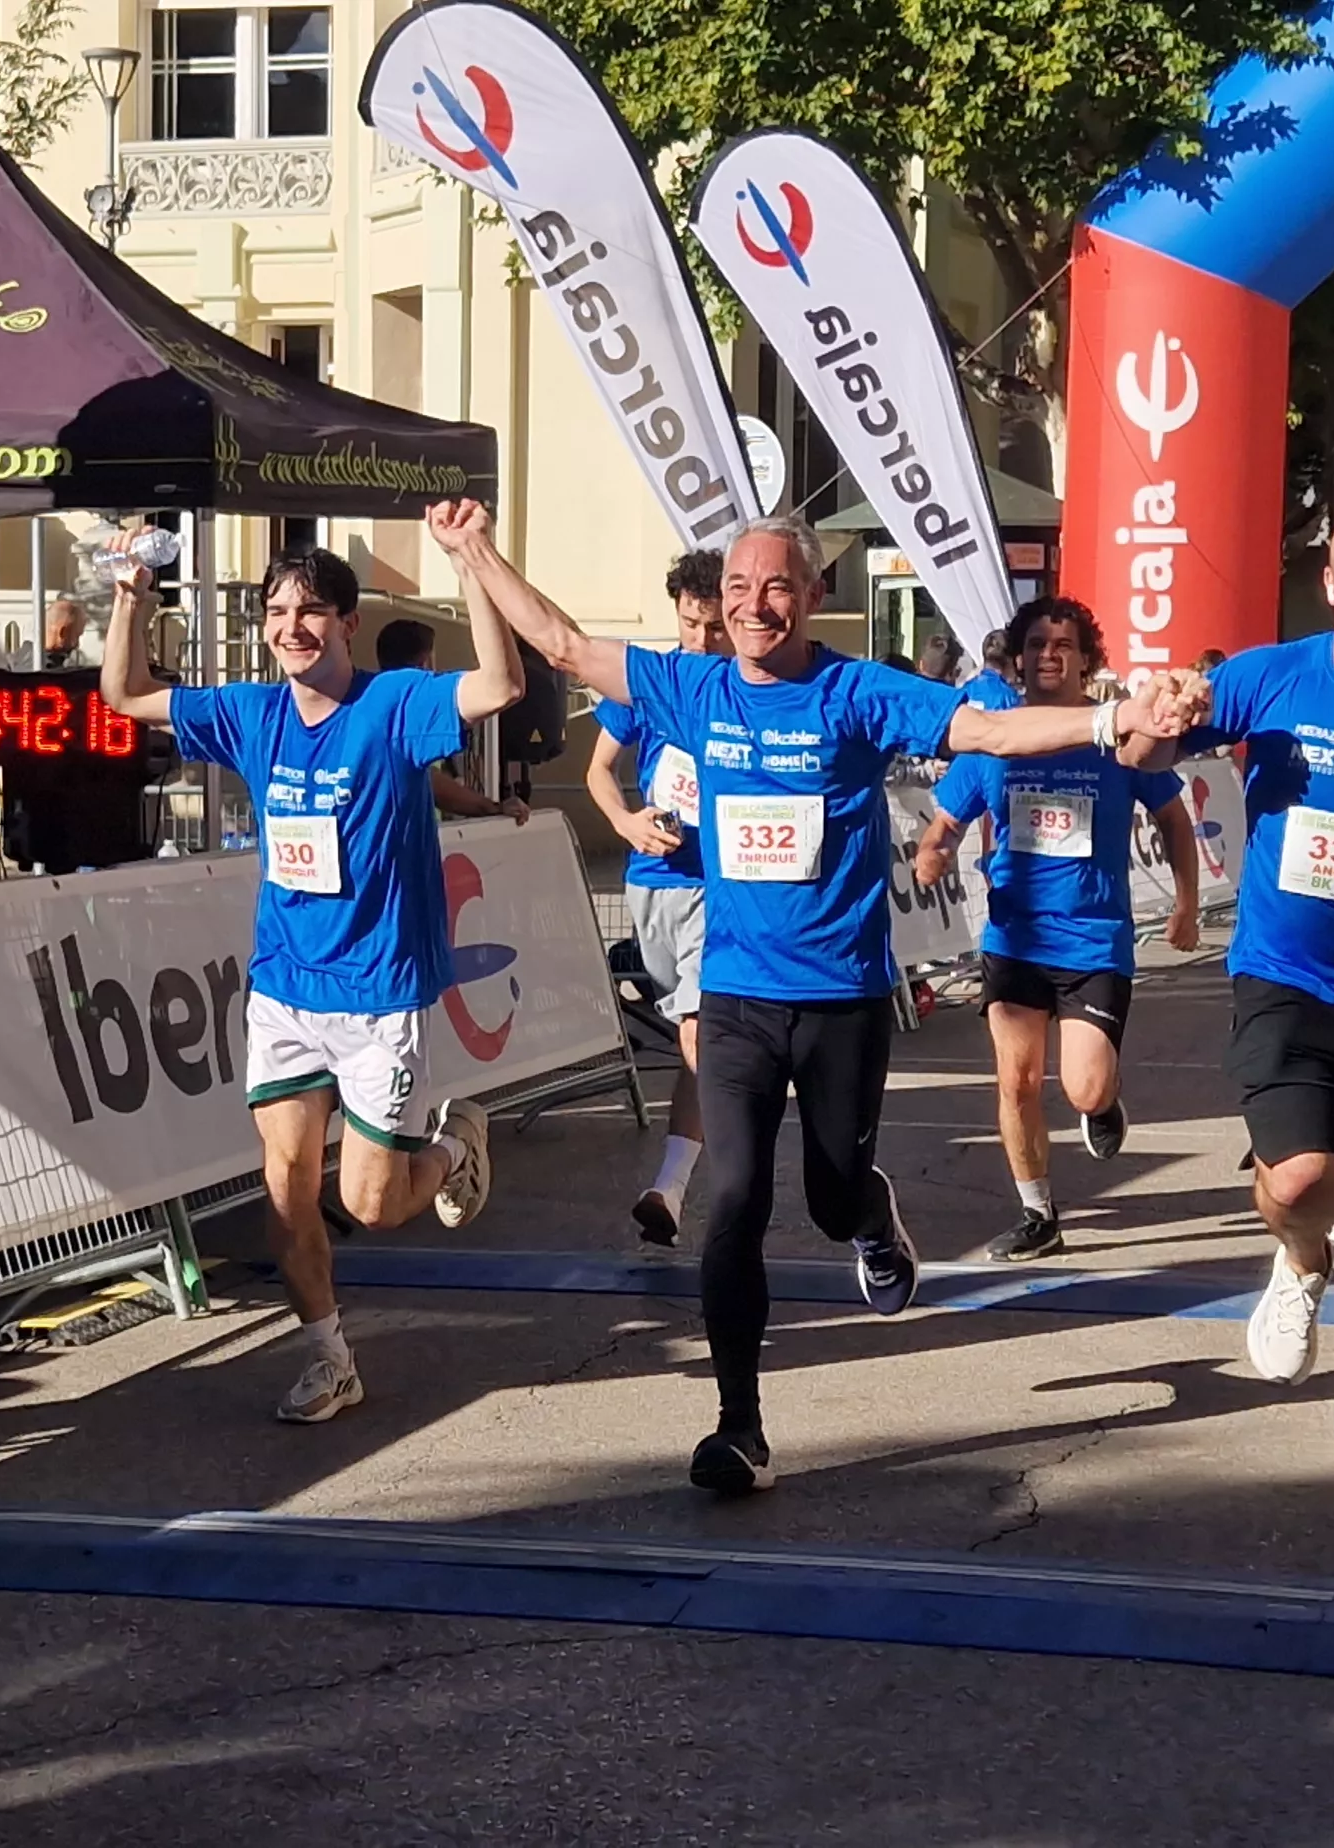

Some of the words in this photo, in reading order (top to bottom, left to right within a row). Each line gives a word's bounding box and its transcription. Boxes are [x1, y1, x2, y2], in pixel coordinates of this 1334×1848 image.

[259, 440, 468, 503] www.fartlecksport.com
[705, 740, 752, 760] NEXT
[1029, 808, 1071, 830] 393
[739, 825, 796, 849] 332
[737, 853, 798, 863] ENRIQUE
[1310, 875, 1332, 890] 8K
[26, 933, 251, 1124] Iber
